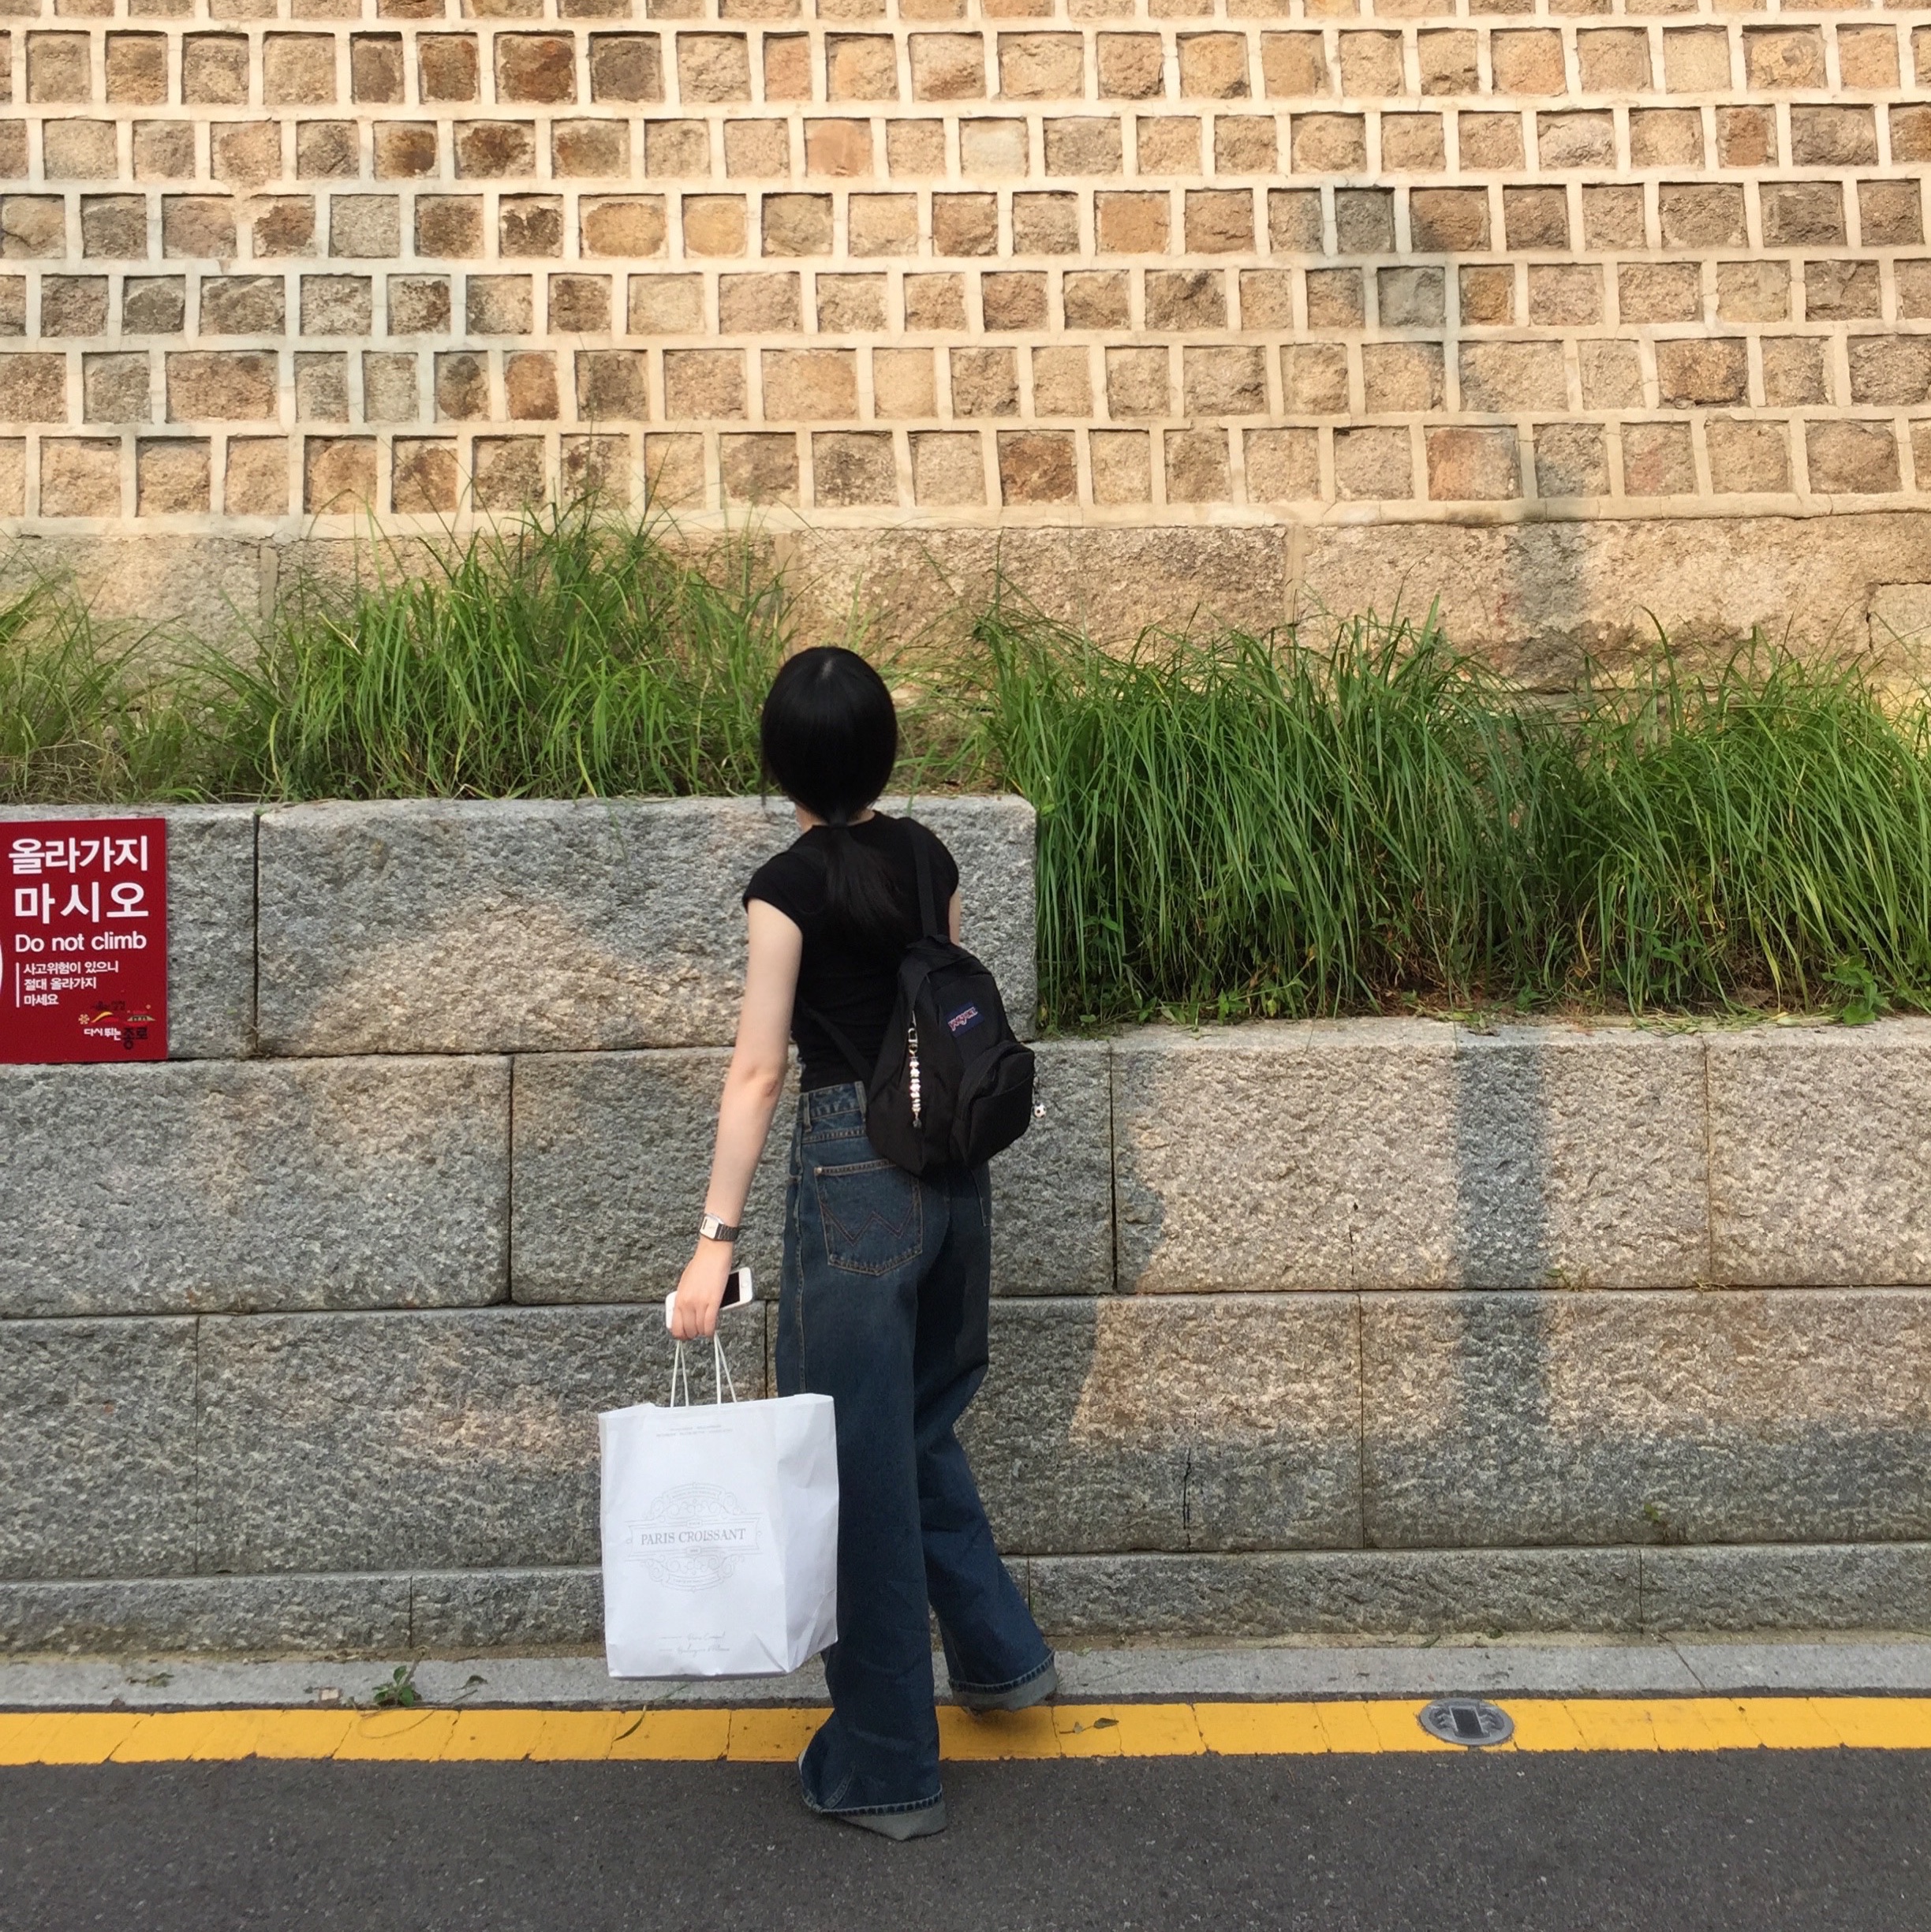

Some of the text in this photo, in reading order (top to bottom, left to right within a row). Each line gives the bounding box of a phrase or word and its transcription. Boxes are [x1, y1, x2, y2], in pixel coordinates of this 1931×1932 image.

[8, 835, 148, 875] 올라가지
[14, 881, 149, 925] 마시오
[15, 930, 147, 952] Do not climb
[23, 960, 119, 975] 사고위험이 있으니
[24, 977, 97, 992] 절대 올라가지
[24, 993, 59, 1007] 마세요
[84, 1028, 103, 1037] 다시
[122, 1026, 148, 1050] 종로
[641, 1528, 746, 1545] PARIS CROISSANT
